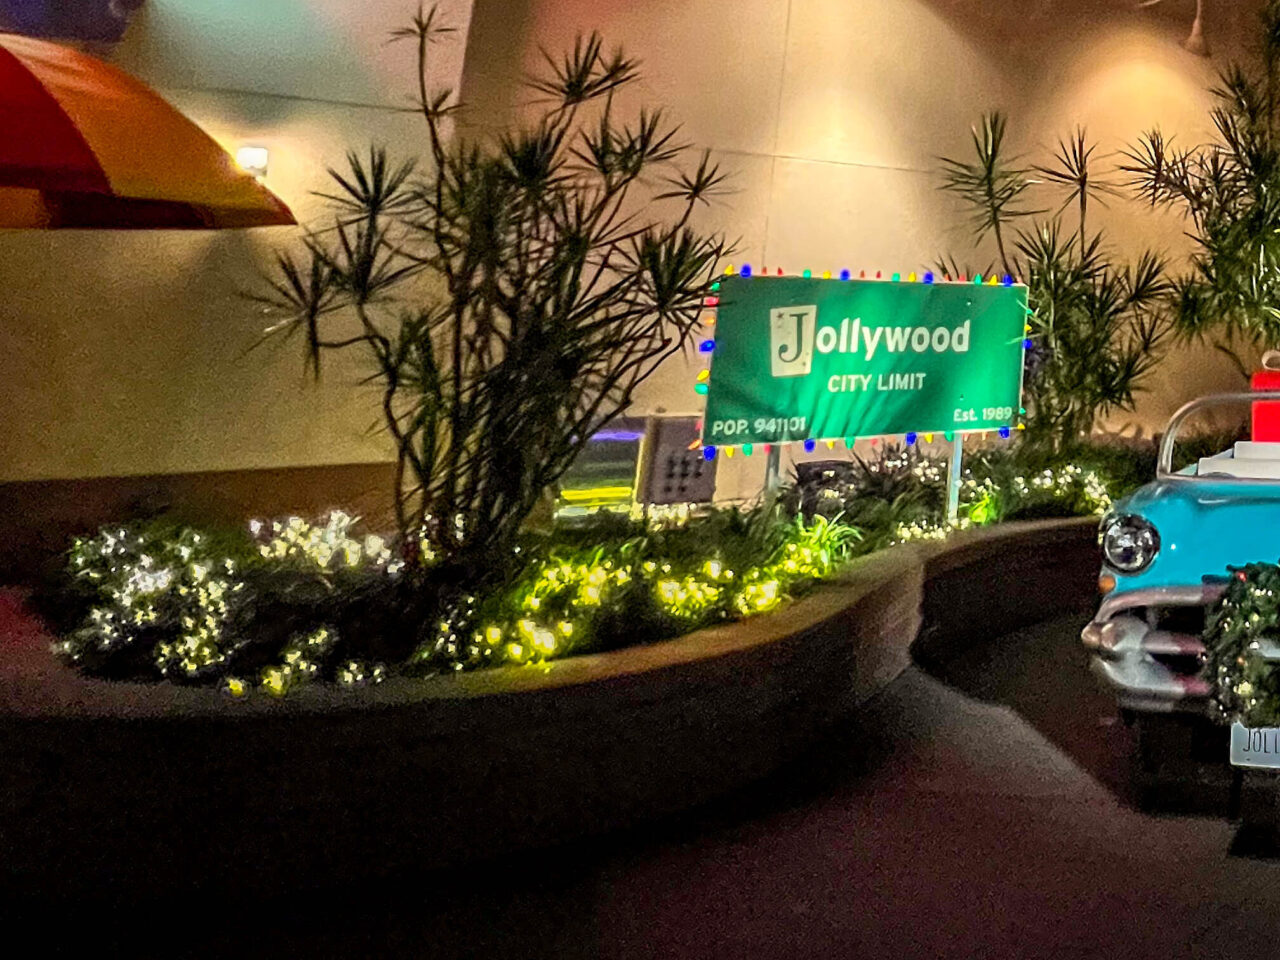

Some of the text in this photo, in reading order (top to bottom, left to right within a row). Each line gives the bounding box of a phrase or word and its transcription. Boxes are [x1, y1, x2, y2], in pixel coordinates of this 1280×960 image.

[776, 311, 971, 364] Jollywood
[828, 372, 926, 393] CITY LIMIT
[953, 406, 1013, 422] Est. 1989
[711, 419, 750, 436] POP.
